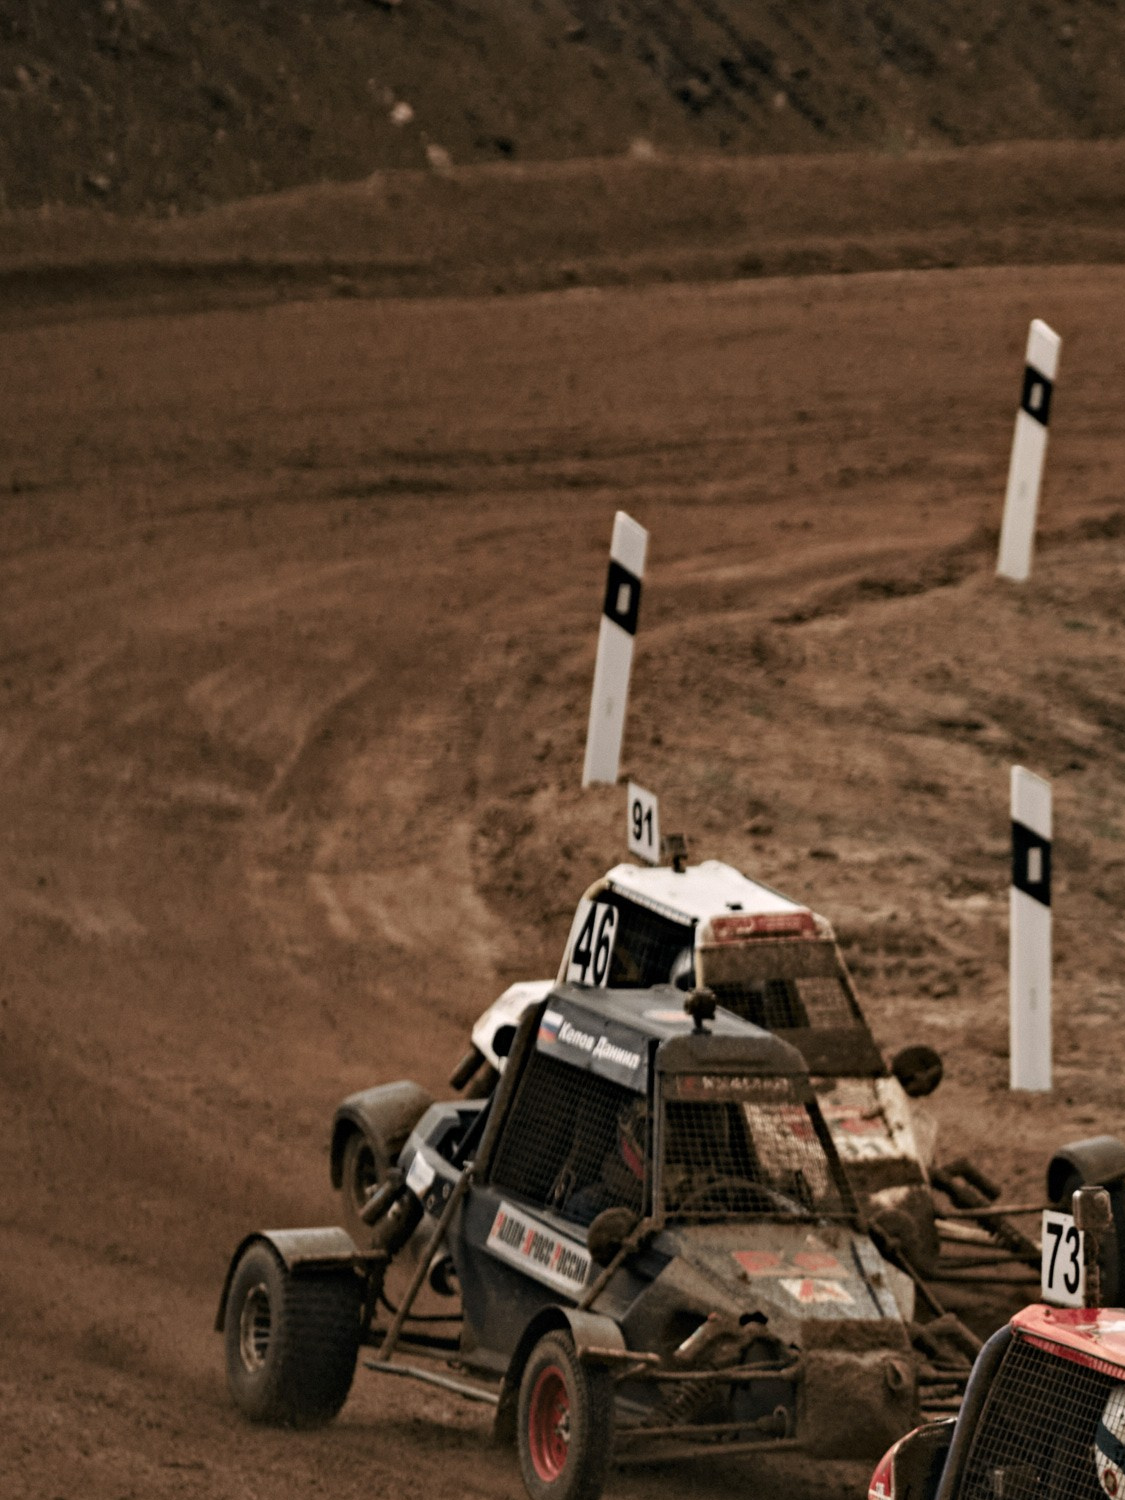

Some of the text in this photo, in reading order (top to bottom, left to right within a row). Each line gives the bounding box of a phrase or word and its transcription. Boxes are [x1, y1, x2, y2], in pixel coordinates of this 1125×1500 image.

[632, 798, 653, 847] 91
[572, 902, 616, 988] 46
[592, 1034, 641, 1071] Даниил
[1046, 1221, 1080, 1295] 73
